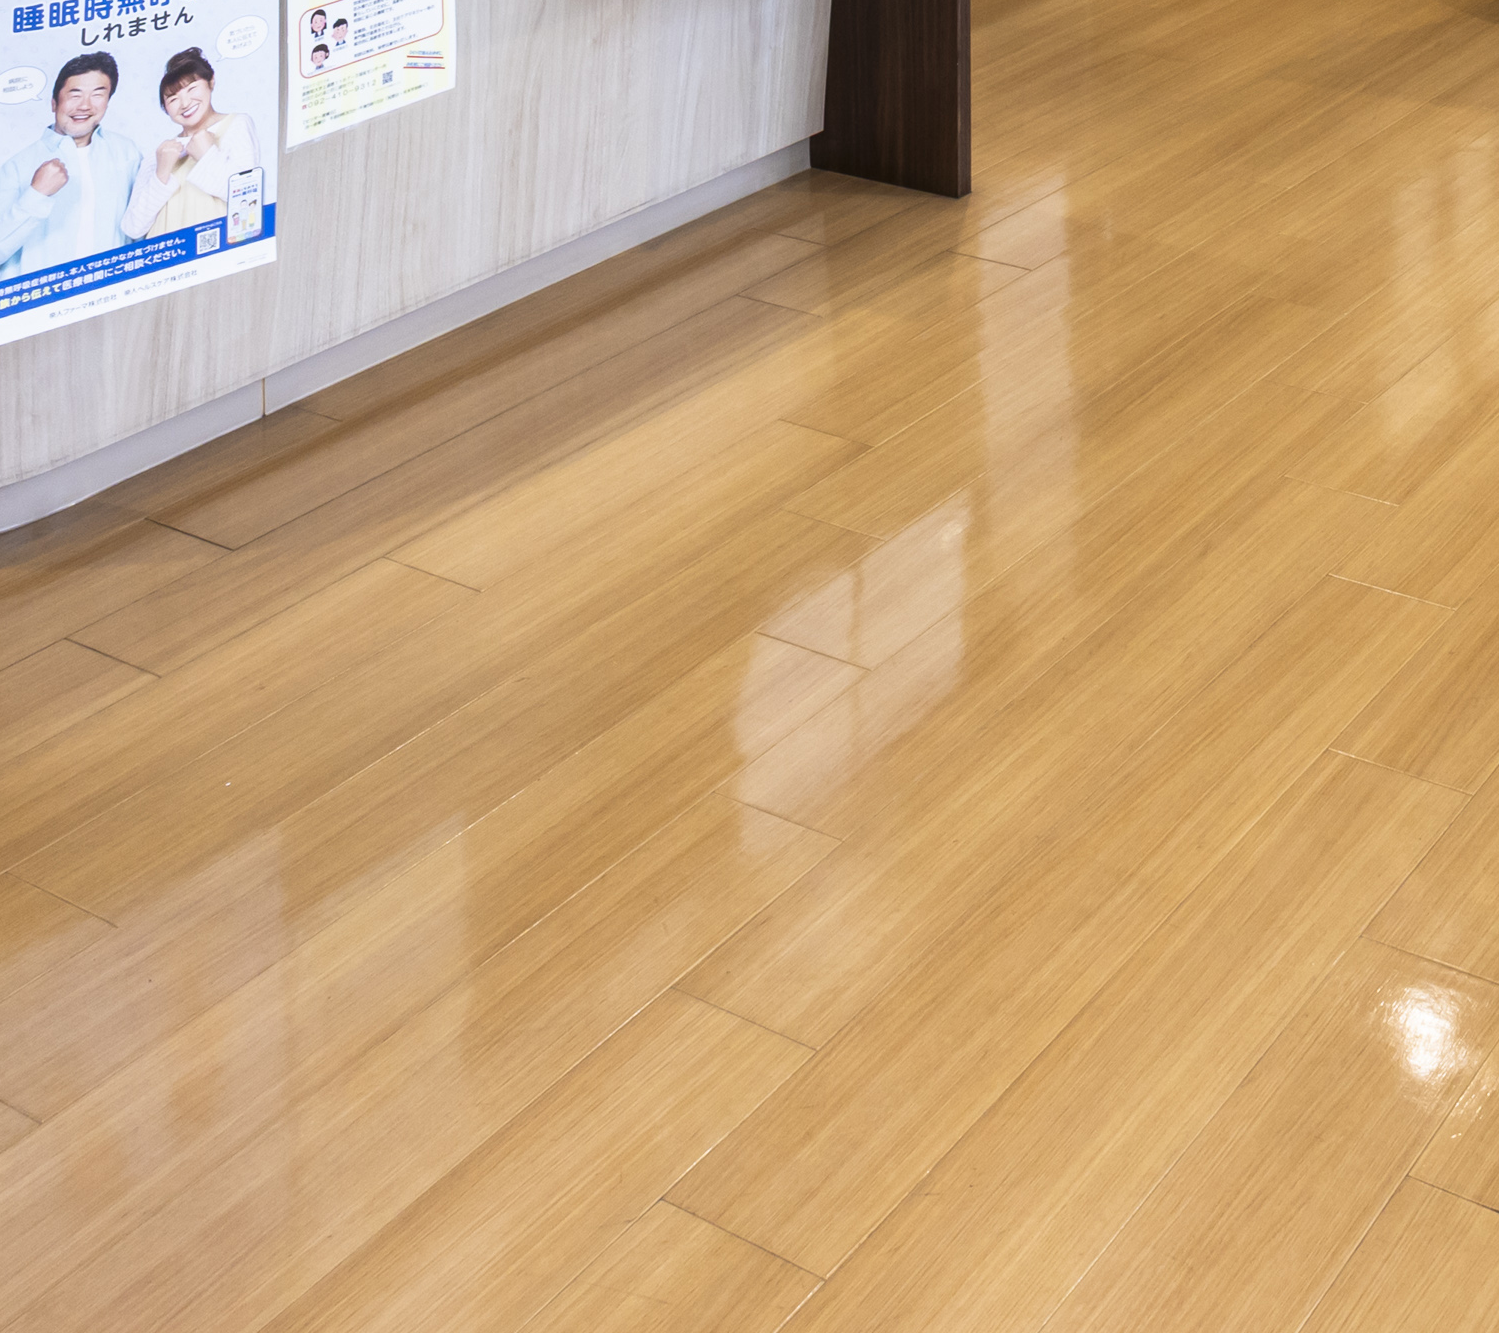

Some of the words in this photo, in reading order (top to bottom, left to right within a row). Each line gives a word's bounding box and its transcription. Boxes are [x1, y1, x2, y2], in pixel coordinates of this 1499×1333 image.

[80, 6, 195, 47] しれません
[48, 293, 117, 319] 帝人ファーマ株式会社
[123, 269, 198, 297] 帝人ヘルスケア株式会社
